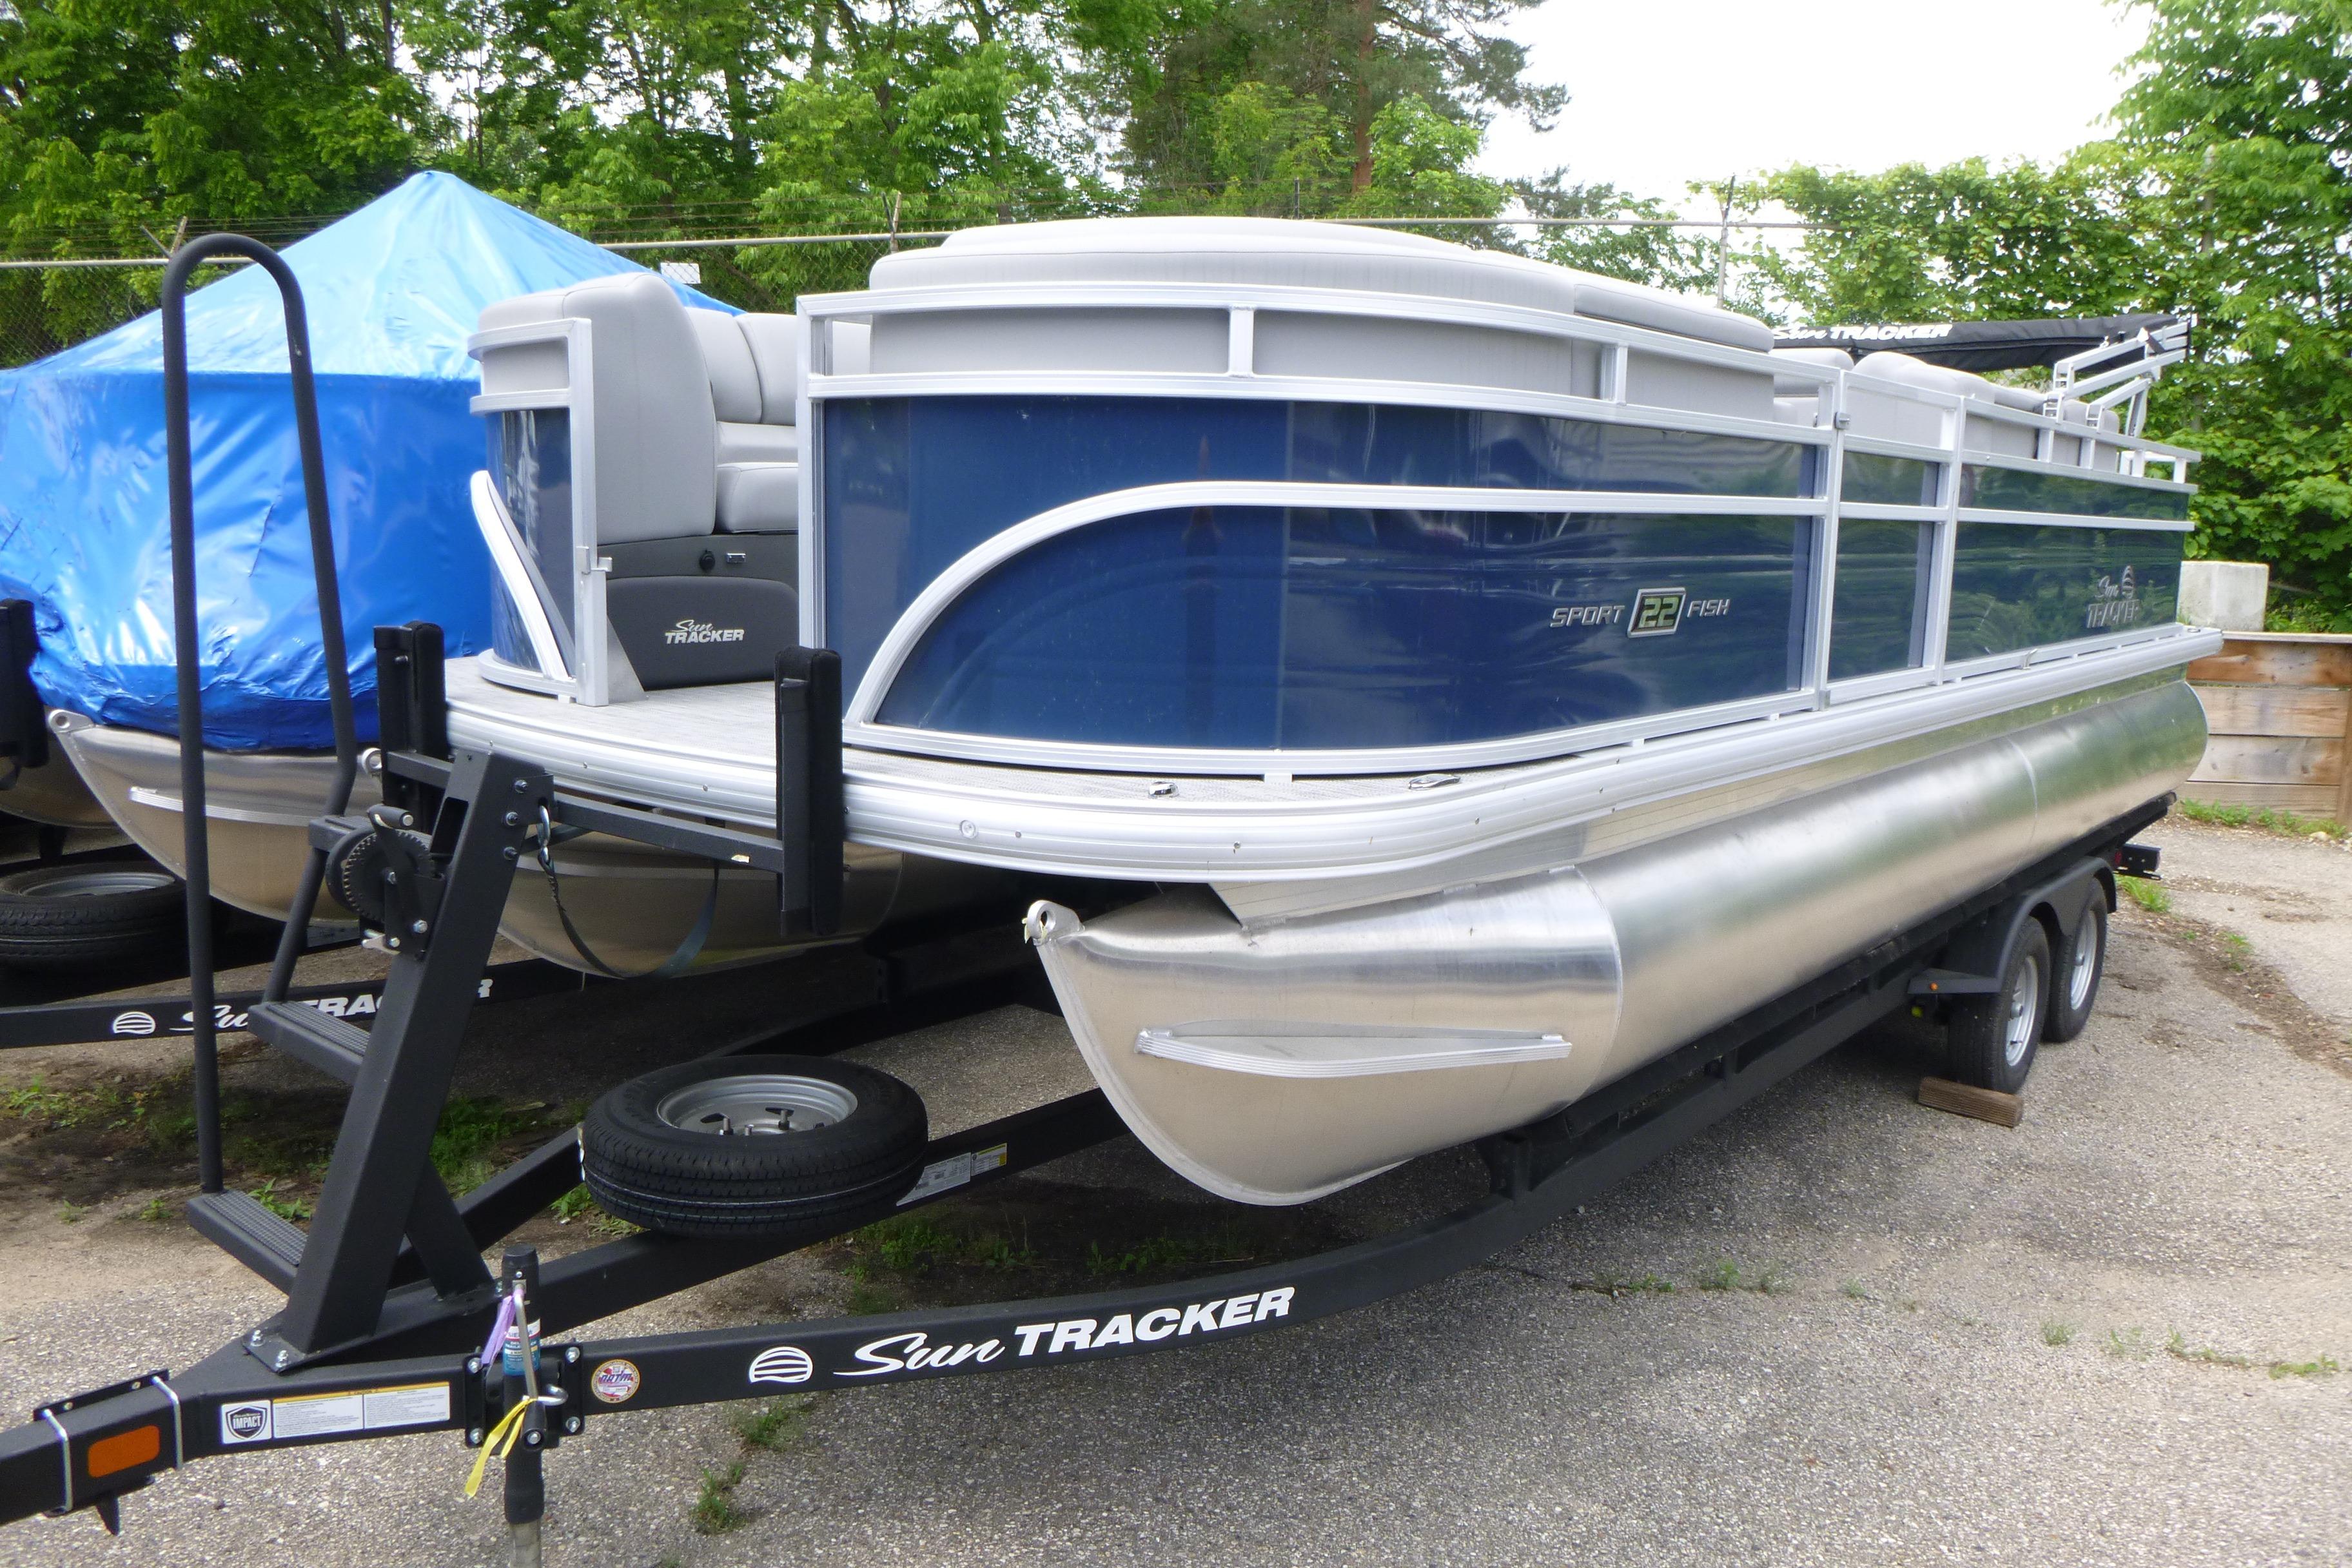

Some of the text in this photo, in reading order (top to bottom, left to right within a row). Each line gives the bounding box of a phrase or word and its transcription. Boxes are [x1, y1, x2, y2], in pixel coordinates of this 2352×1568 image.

[1771, 322, 1953, 340] Sun TRACKER
[1550, 596, 1730, 629] SPORT 22 FISH
[671, 619, 714, 632] Sun
[665, 629, 745, 644] TRACKER
[833, 1287, 1295, 1377] Sun TRACKER
[233, 1416, 261, 1429] IMPACT
